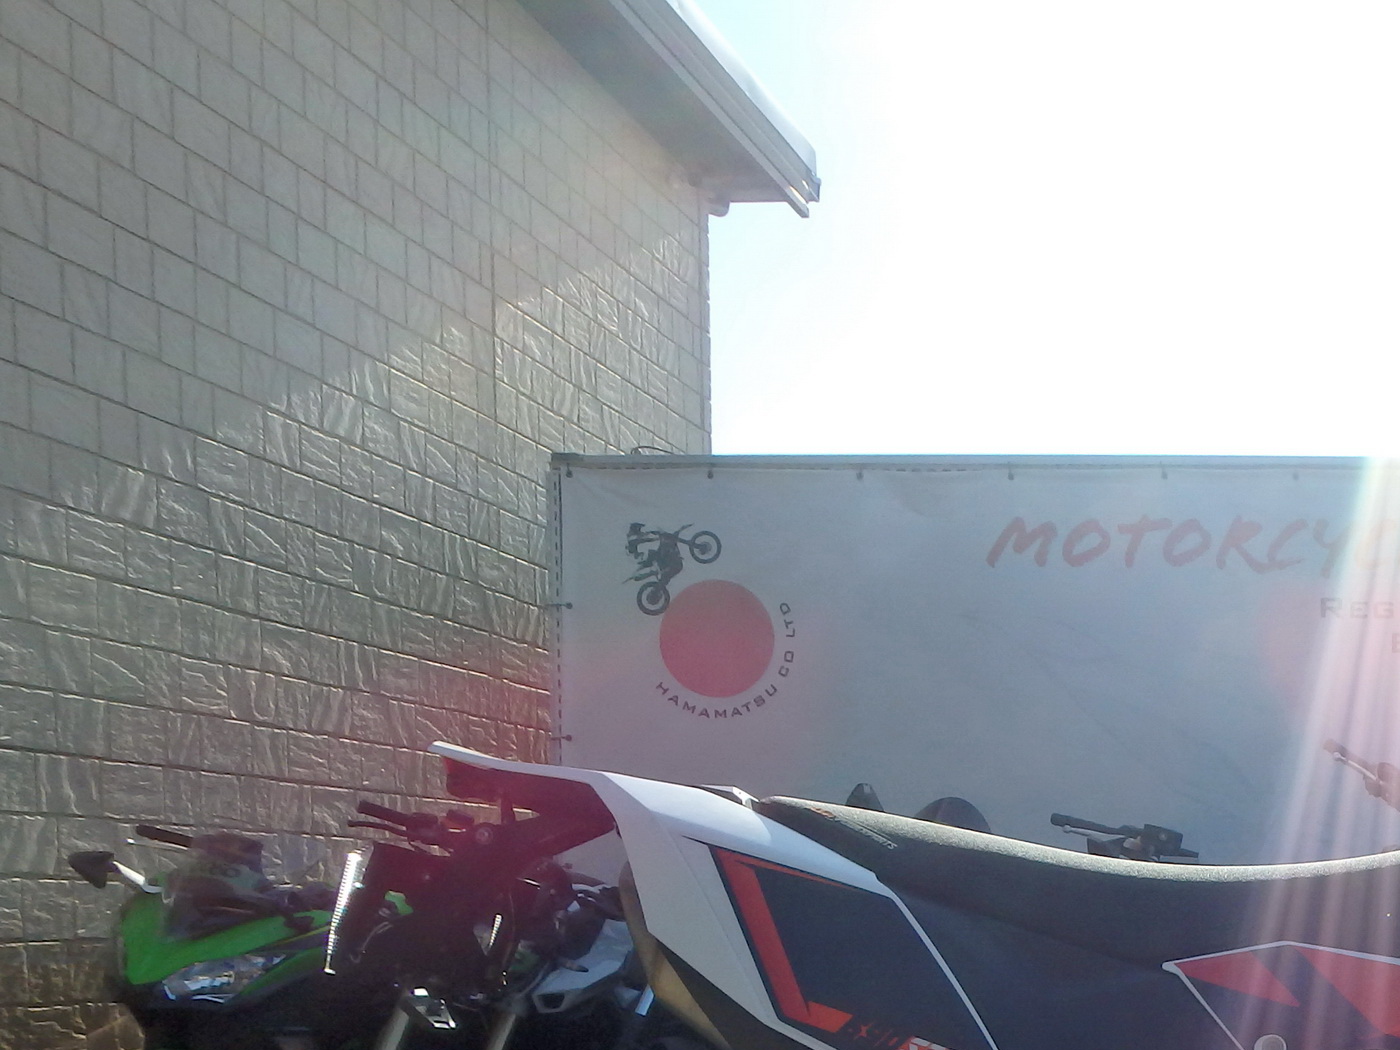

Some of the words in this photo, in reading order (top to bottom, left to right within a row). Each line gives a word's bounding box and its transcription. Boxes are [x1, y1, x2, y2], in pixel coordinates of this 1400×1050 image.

[779, 602, 796, 638] LTD
[778, 650, 795, 677] CO
[655, 681, 778, 719] HAMAMATSU
